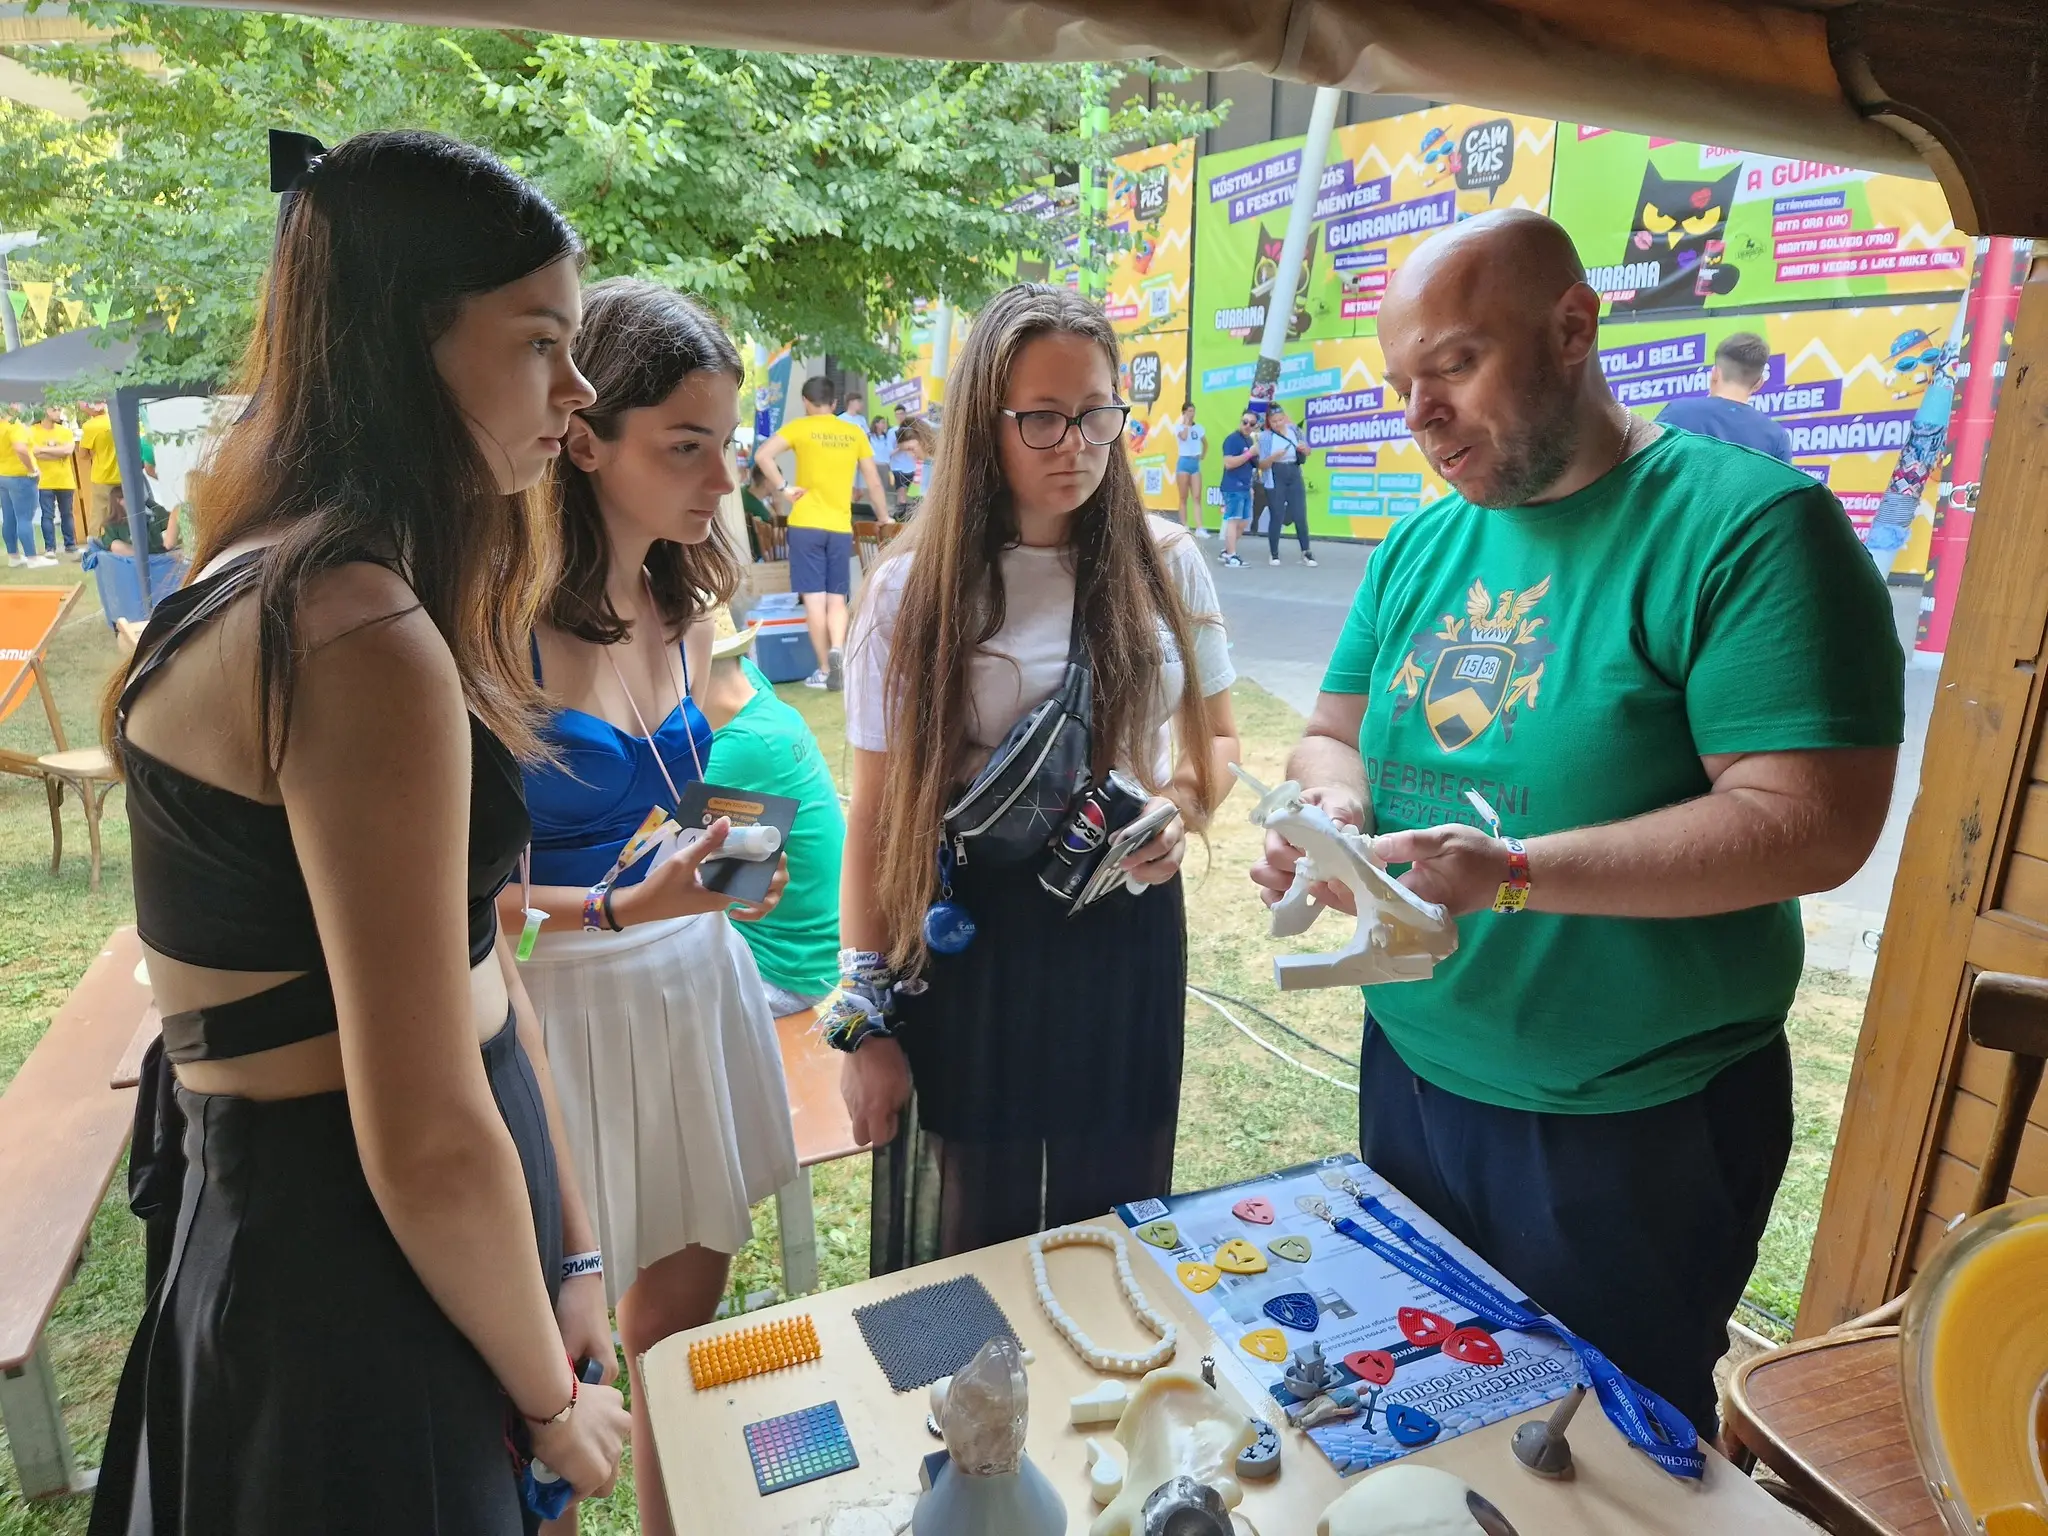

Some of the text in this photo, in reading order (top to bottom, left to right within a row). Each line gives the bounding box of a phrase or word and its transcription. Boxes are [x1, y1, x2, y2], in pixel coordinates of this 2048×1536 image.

[1212, 156, 1297, 199] KÓSTOLJ BELE
[1747, 169, 1763, 191] A
[1235, 200, 1245, 217] A
[1329, 201, 1450, 247] GUARANÁVAL!
[1775, 213, 1848, 232] RITA ORA (UK)
[1777, 240, 1817, 255] MARTIN
[1865, 232, 1895, 247] (FRA)
[1780, 250, 1961, 278] DIMITRI VEGAS & LIKE MIKE (BEL)
[1215, 305, 1265, 329] GUARANA
[1648, 342, 1696, 365] BELE
[1308, 392, 1378, 416] PÖRÖGJ FEL
[1463, 657, 1496, 675] 15 38
[1368, 757, 1531, 816] DEBRECENI
[562, 1255, 602, 1277] AMPUS
[1409, 1265, 1442, 1288] EGYETEM
[1607, 1378, 1638, 1425] DEBRECENI
